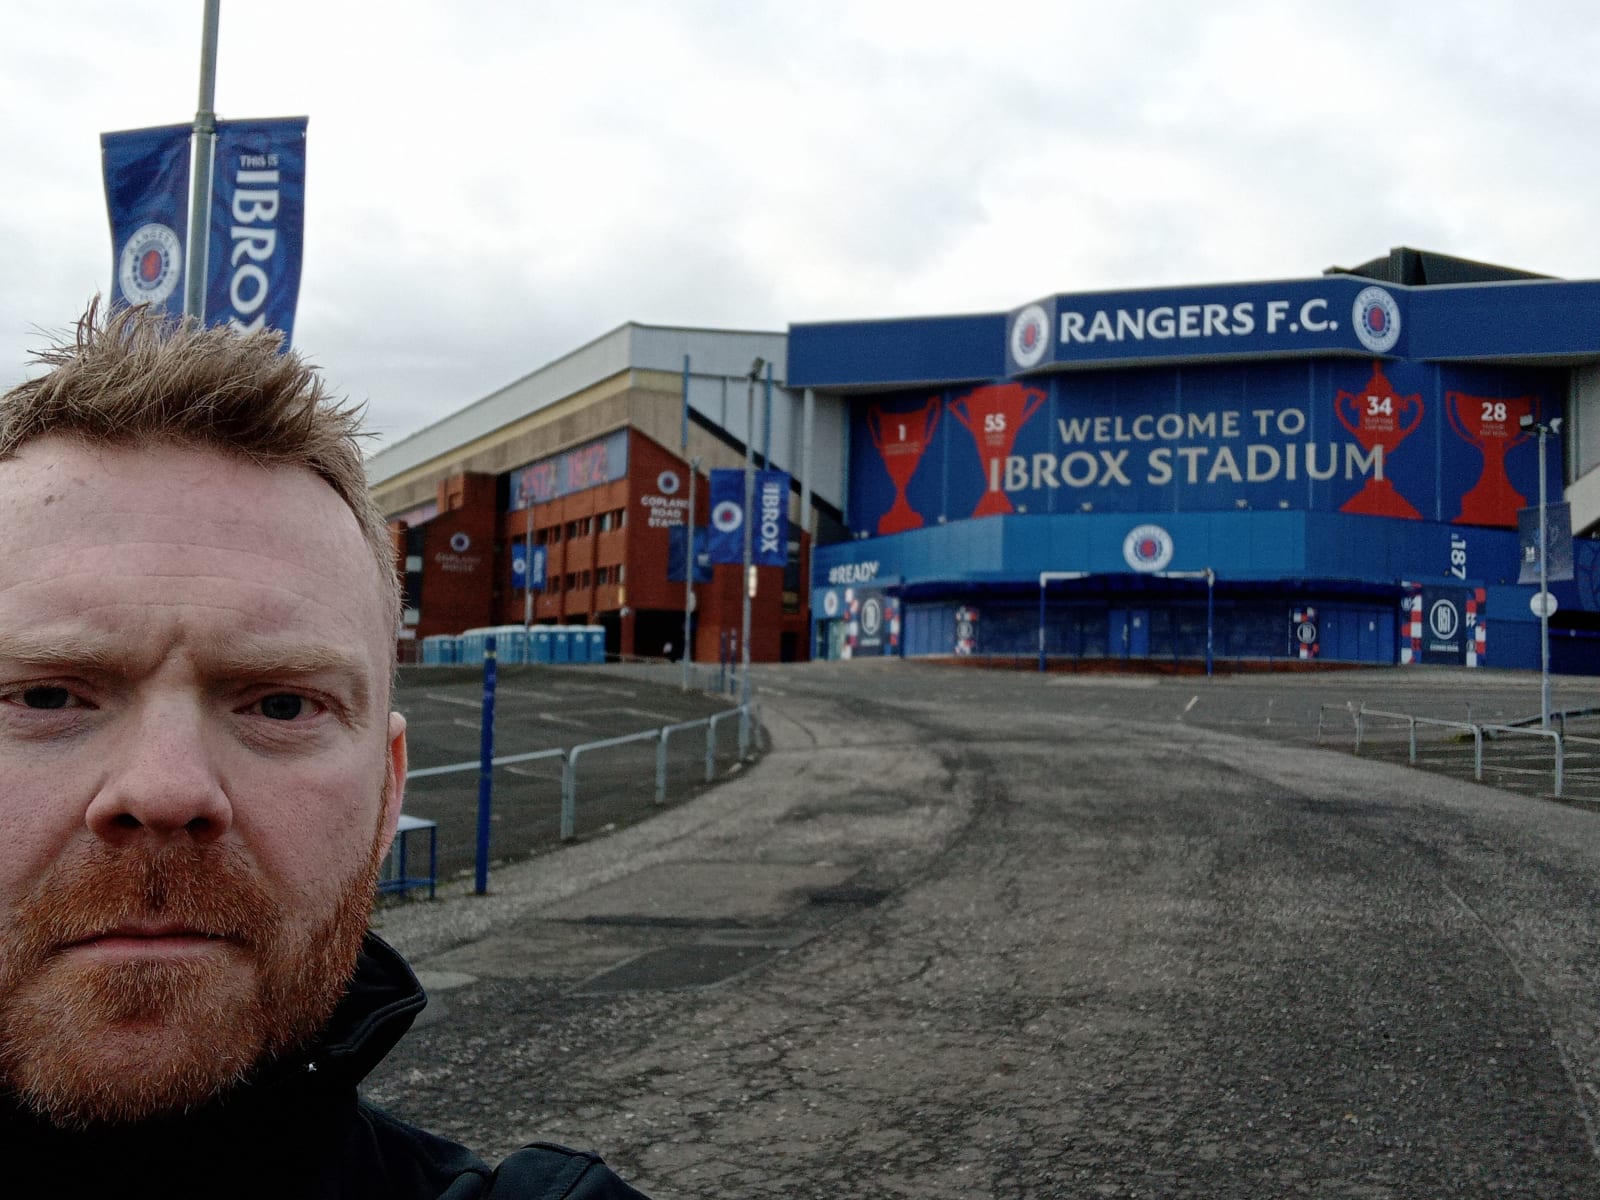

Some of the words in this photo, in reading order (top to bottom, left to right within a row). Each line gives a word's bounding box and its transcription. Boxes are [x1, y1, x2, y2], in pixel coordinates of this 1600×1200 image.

[267, 153, 280, 167] IS
[1060, 302, 1256, 344] RANGERS
[1266, 299, 1339, 335] F.C.
[1366, 395, 1393, 416] 34
[1480, 401, 1507, 422] 28
[898, 424, 906, 441] 1
[984, 413, 1006, 432] 55
[1058, 411, 1241, 444] WELCOME
[1253, 408, 1306, 438] TO
[989, 449, 1132, 493] IBROX
[1147, 441, 1385, 486] STADIUM
[651, 507, 682, 518] ROAD
[760, 488, 780, 553] IBROX
[828, 561, 879, 584] #READY
